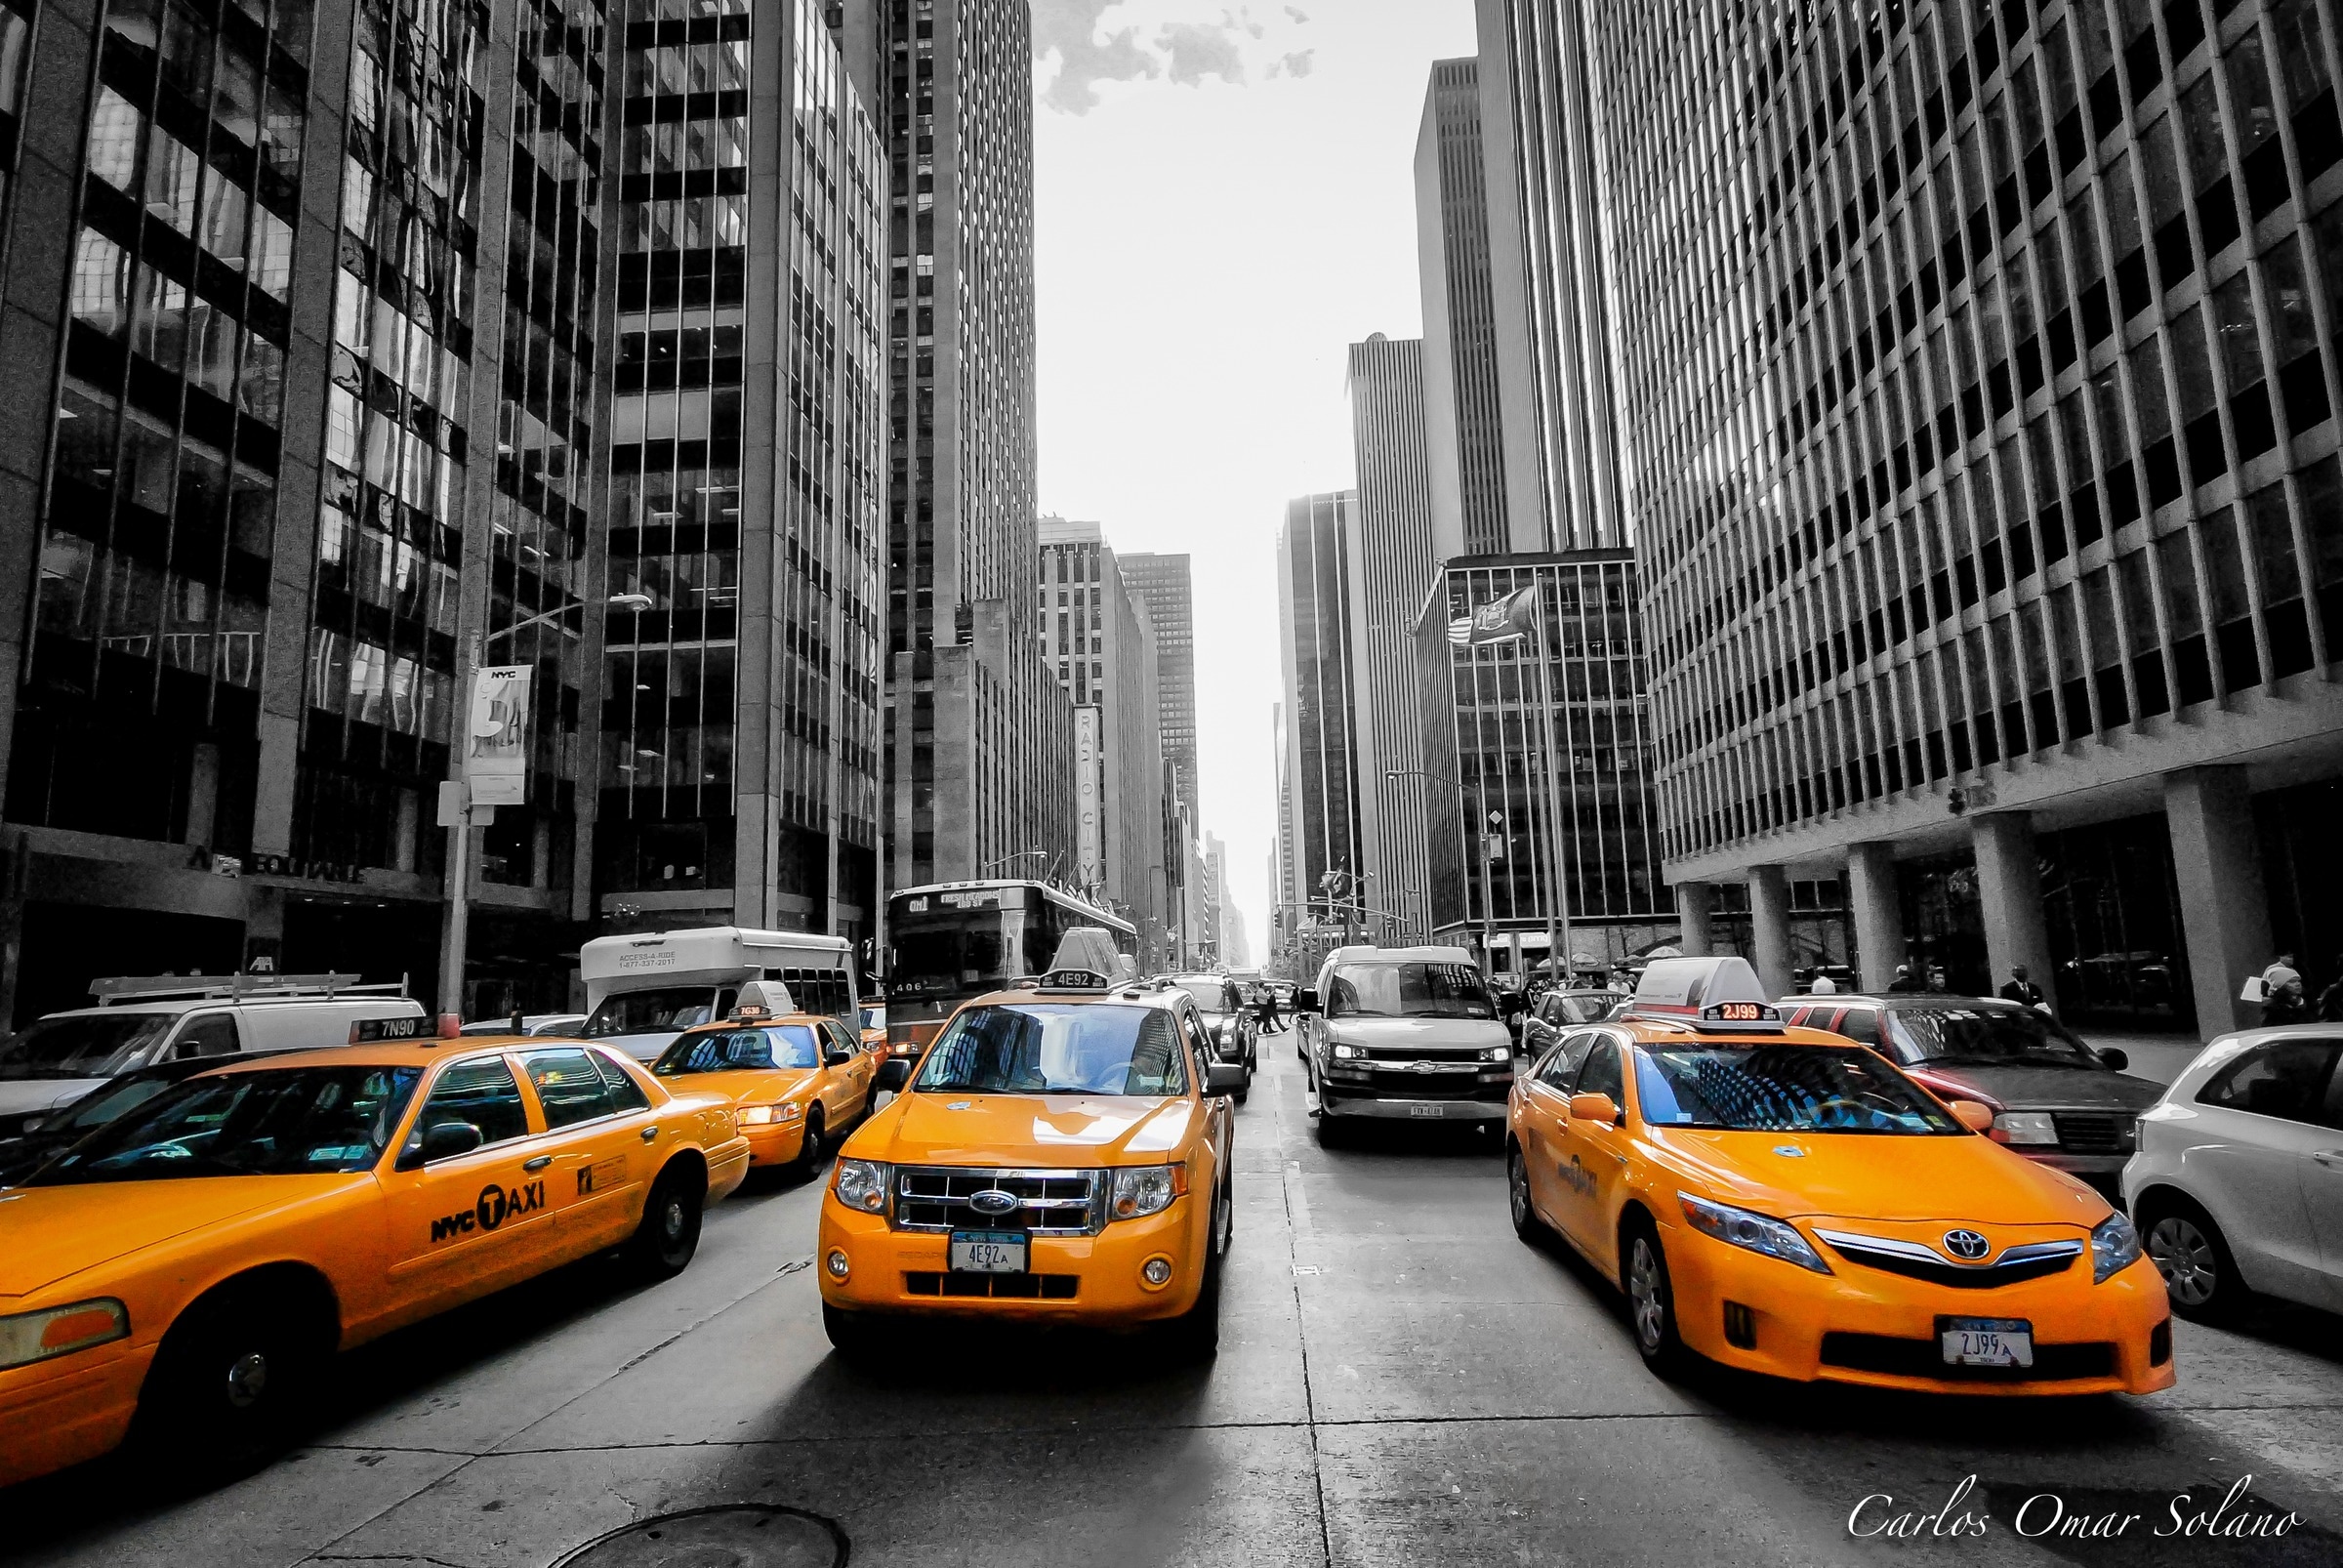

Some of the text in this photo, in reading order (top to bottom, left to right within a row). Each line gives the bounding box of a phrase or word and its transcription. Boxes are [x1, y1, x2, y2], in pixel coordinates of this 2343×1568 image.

[1081, 715, 1094, 876] RADIO CITY
[619, 951, 676, 961] ACCESS-A-RIDE
[1058, 972, 1089, 986] 4E92
[1722, 1004, 1758, 1019] 2J99
[382, 1019, 415, 1037] 7N90
[431, 1180, 545, 1242] NYC TAXI
